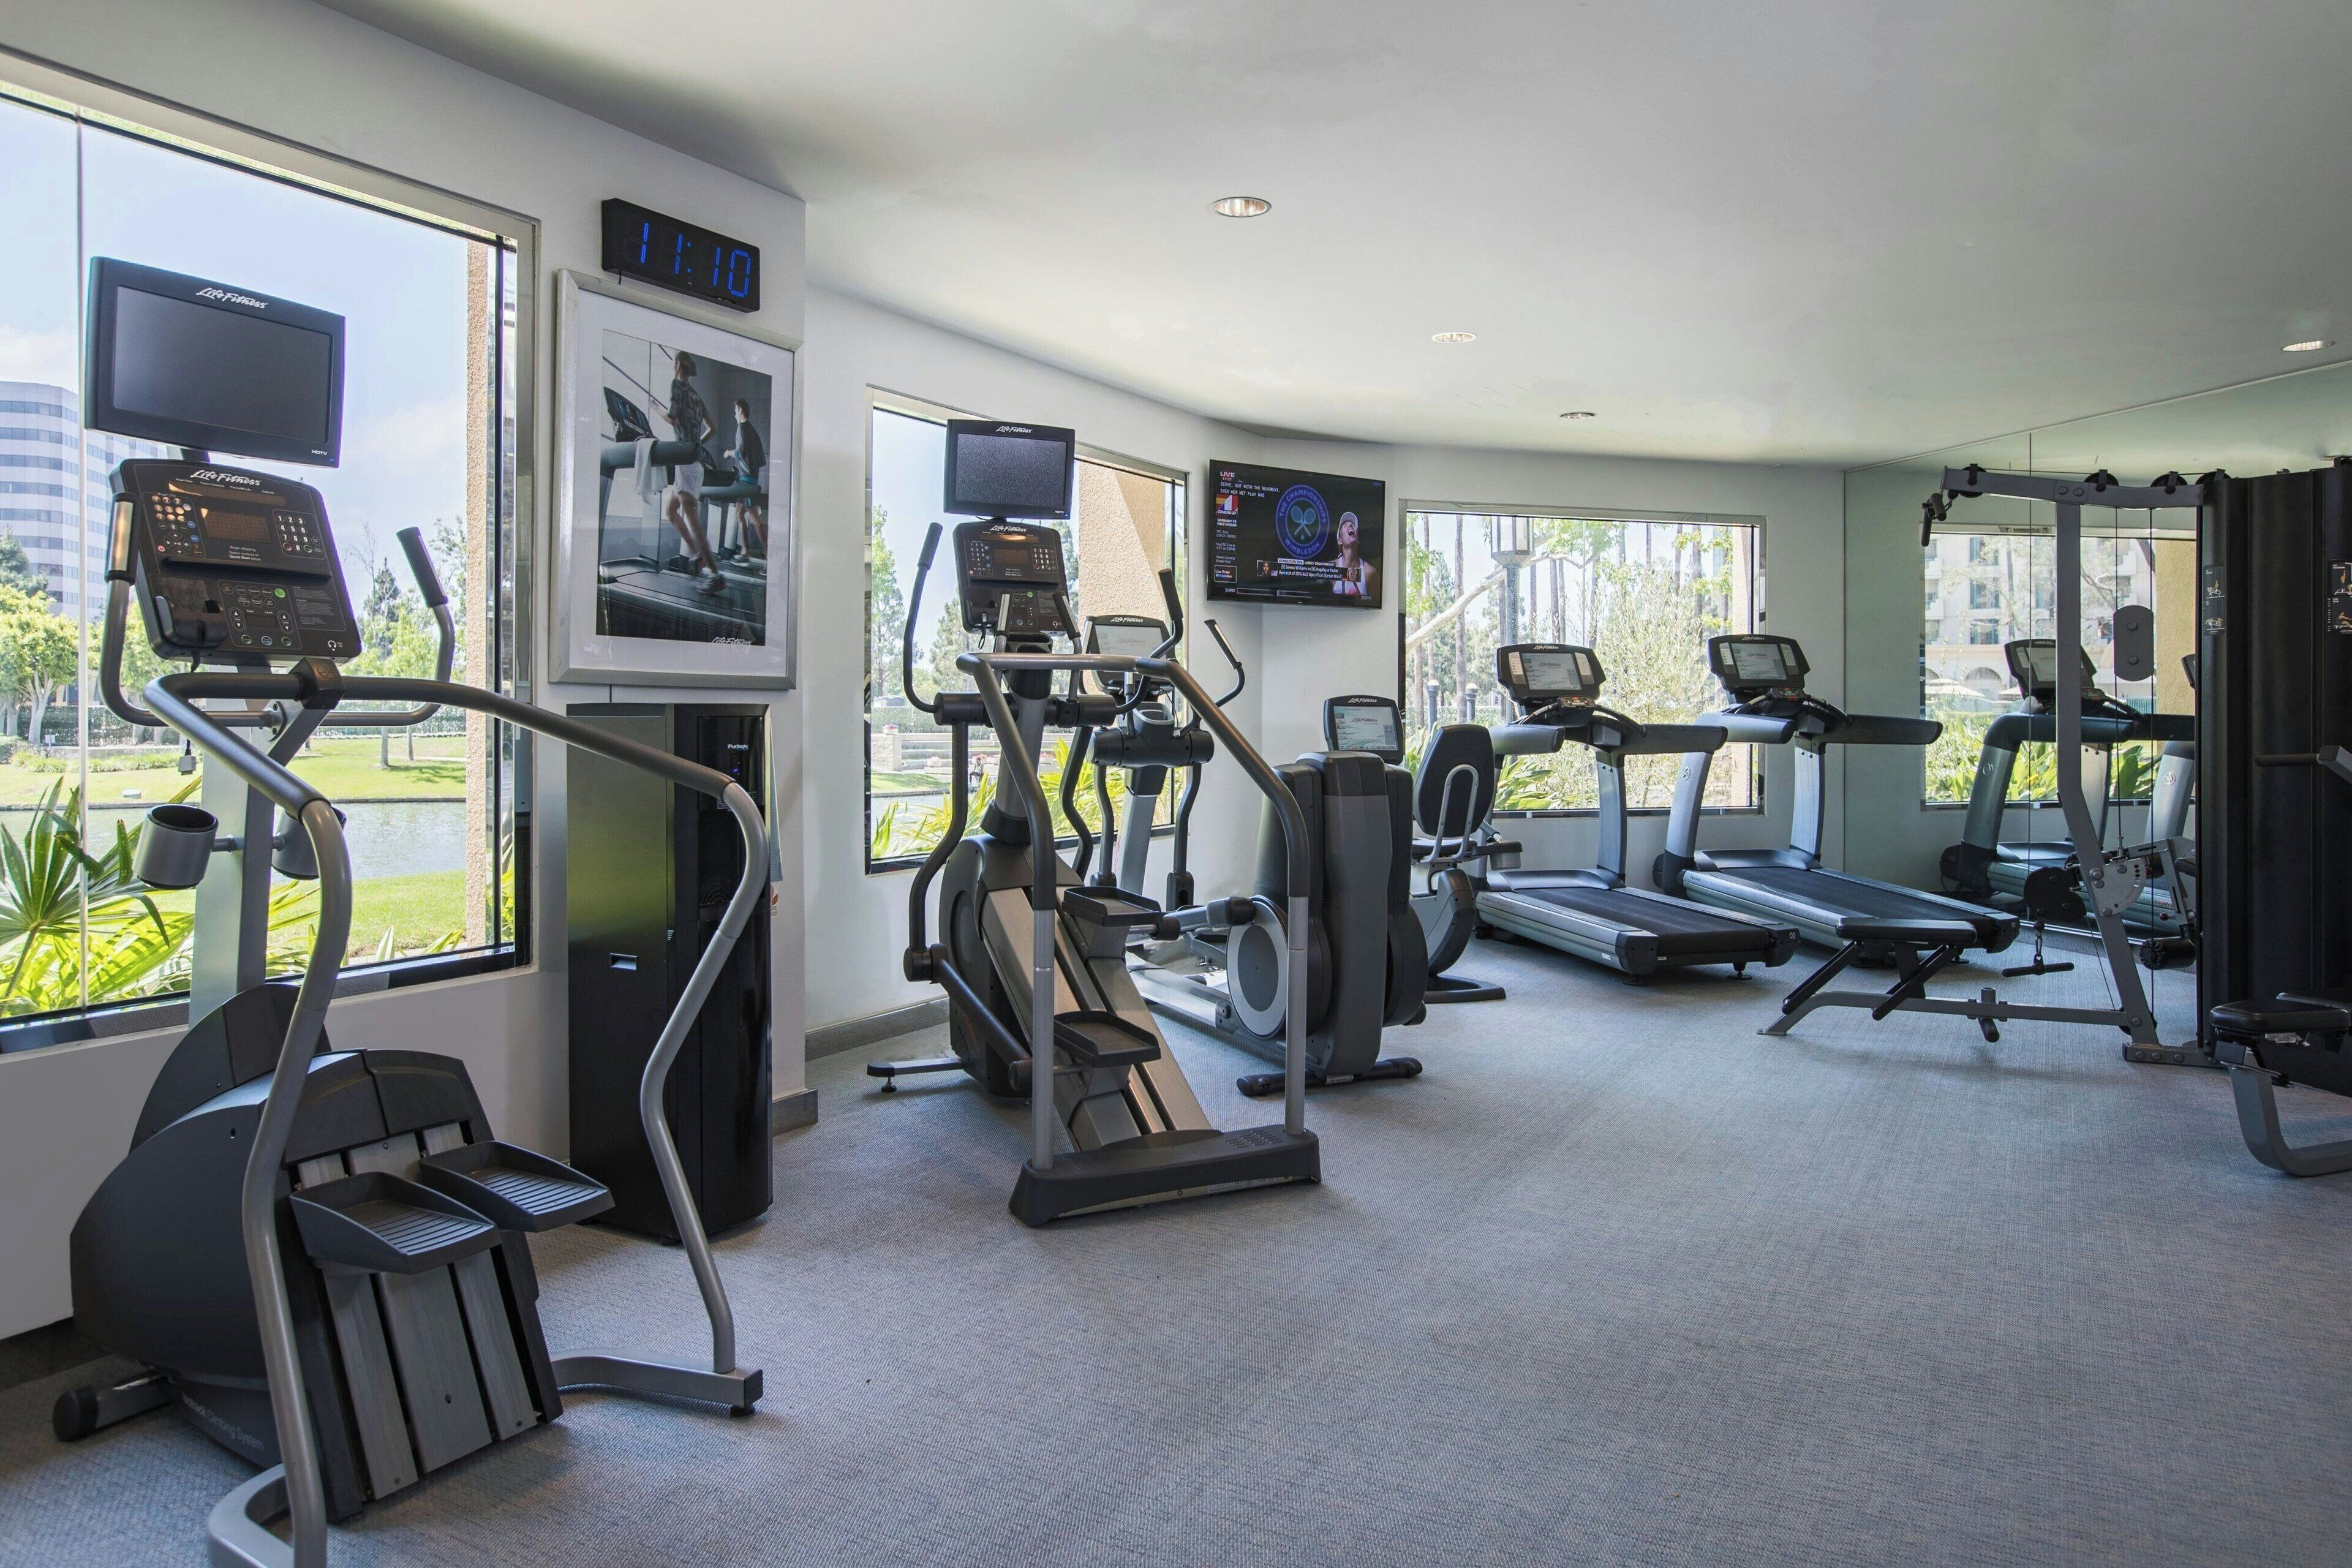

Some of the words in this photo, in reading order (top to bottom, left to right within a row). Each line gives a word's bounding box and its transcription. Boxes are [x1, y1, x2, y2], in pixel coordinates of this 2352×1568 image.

[641, 222, 752, 298] 11:10
[1280, 501, 1288, 517] THE
[1286, 489, 1327, 523] CHAMPIONSHIPS
[1286, 538, 1320, 555] WIMBLEDON
